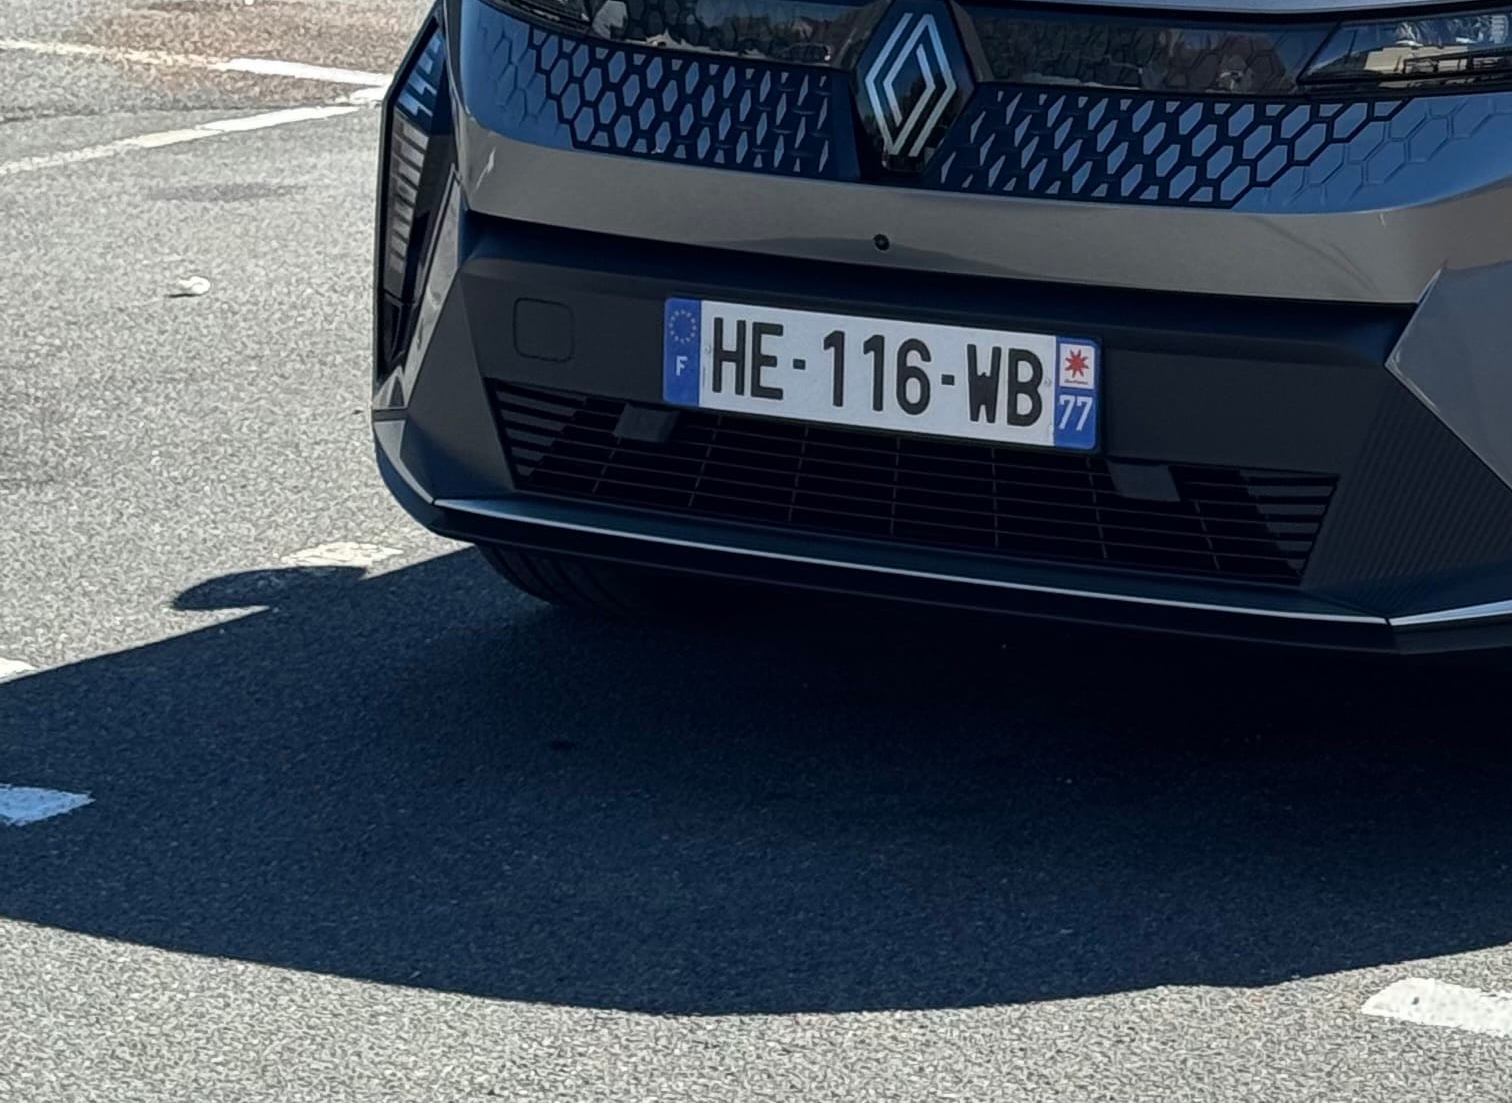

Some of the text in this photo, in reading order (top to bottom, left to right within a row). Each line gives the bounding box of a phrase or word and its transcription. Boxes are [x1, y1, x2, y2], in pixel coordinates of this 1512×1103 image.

[676, 356, 688, 376] F
[711, 317, 1044, 427] HE-116-WB
[1059, 394, 1093, 431] 77
